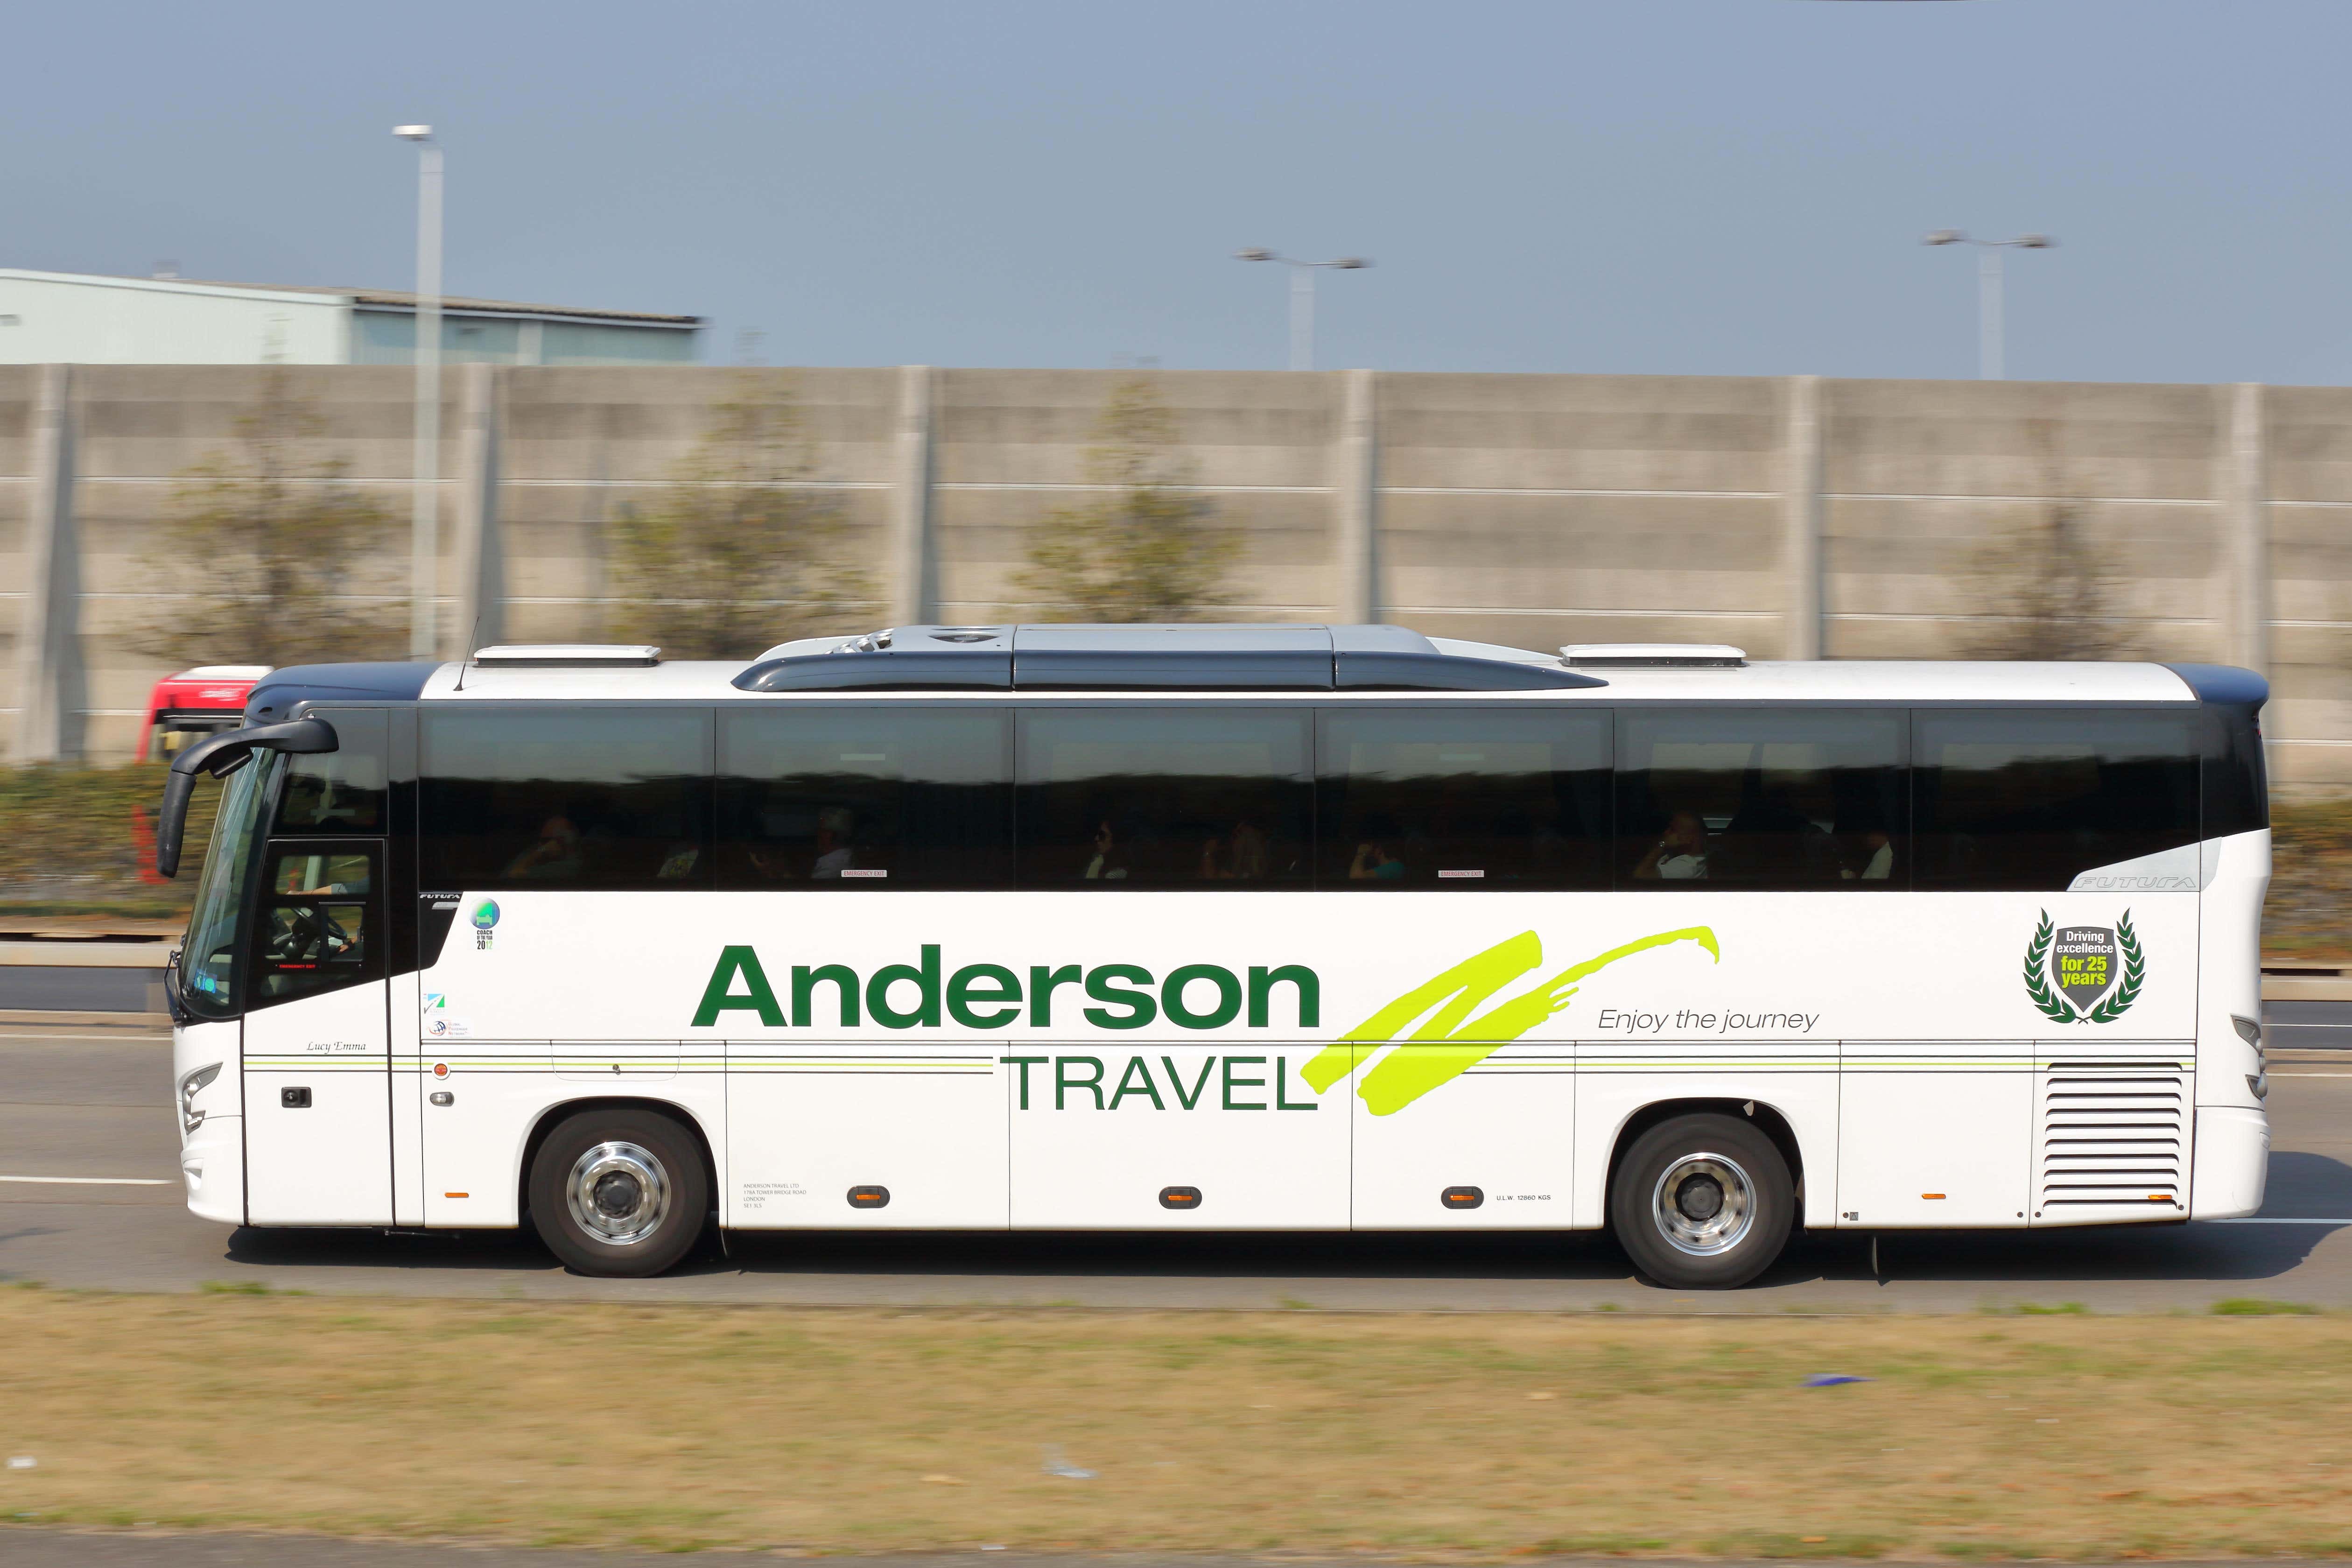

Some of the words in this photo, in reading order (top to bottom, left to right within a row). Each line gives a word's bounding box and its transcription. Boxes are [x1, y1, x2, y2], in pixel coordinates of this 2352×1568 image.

[2073, 877, 2196, 888] FUTURA
[477, 940, 493, 949] 2012
[2066, 931, 2105, 943] Driving
[2056, 943, 2114, 954] excellence
[2061, 955, 2085, 972] for
[2087, 956, 2107, 972] 25
[690, 943, 1320, 1030] Anderson
[2061, 972, 2107, 989] years
[1598, 1009, 1669, 1034] Enjoy
[1676, 1009, 1717, 1028] the
[1719, 1009, 1820, 1034] journey
[306, 1041, 331, 1055] Lucy
[334, 1041, 366, 1050] Emma
[1000, 1055, 1319, 1111] TRAVEL
